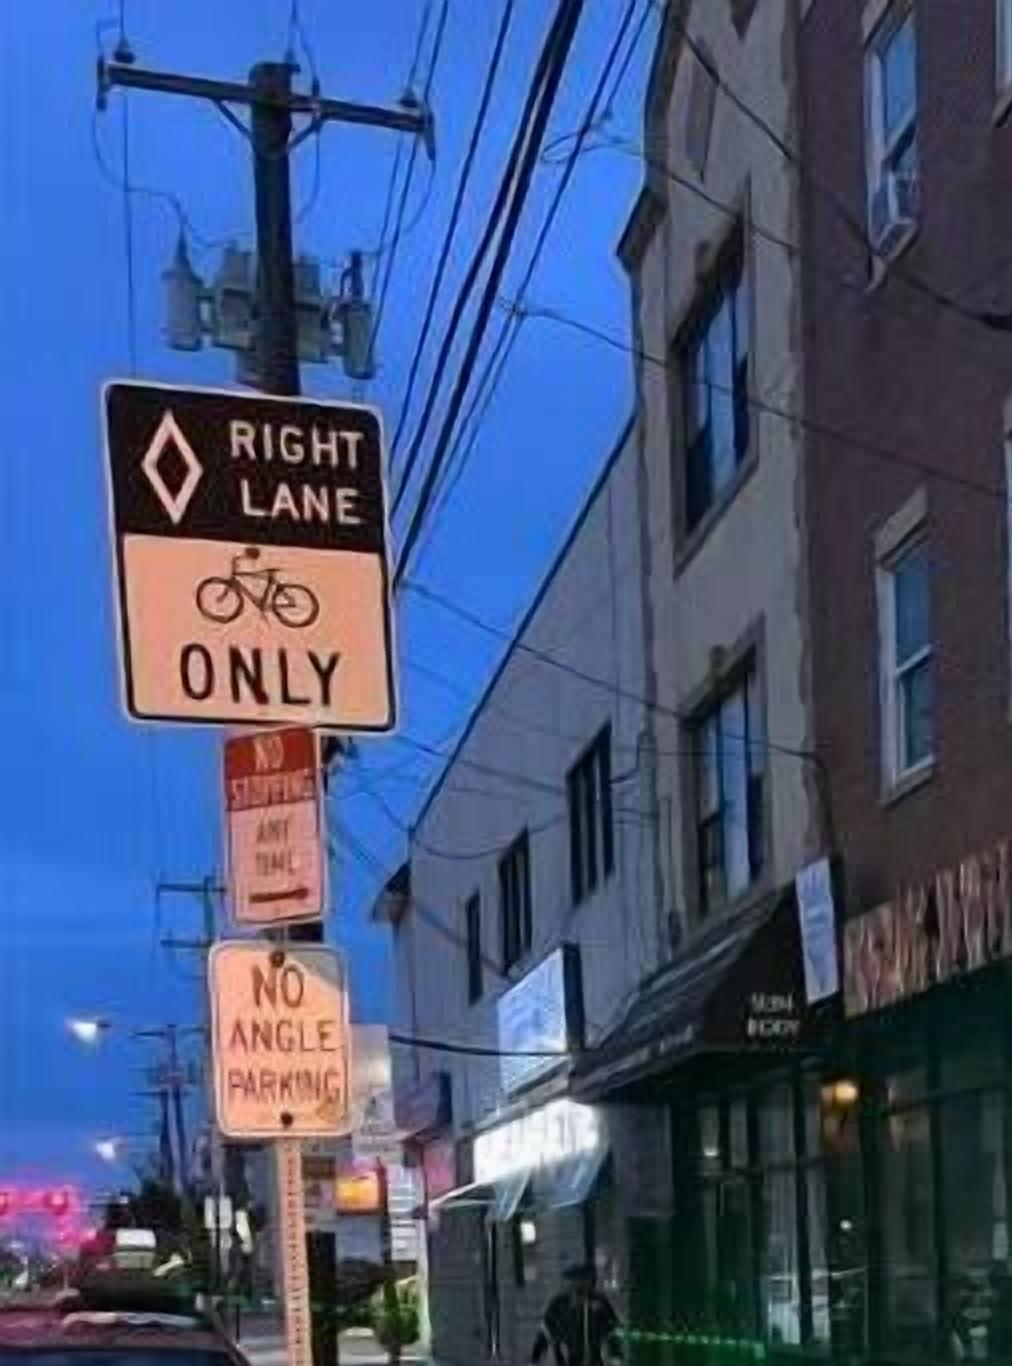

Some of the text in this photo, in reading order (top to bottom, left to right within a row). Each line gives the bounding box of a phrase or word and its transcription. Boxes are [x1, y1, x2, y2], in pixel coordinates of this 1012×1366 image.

[229, 419, 364, 470] RIGHT
[241, 480, 363, 525] LANE
[179, 643, 340, 707] ONLY
[251, 962, 304, 1008] NO
[229, 1019, 338, 1053] ANGLE
[228, 1067, 341, 1104] PARKING
